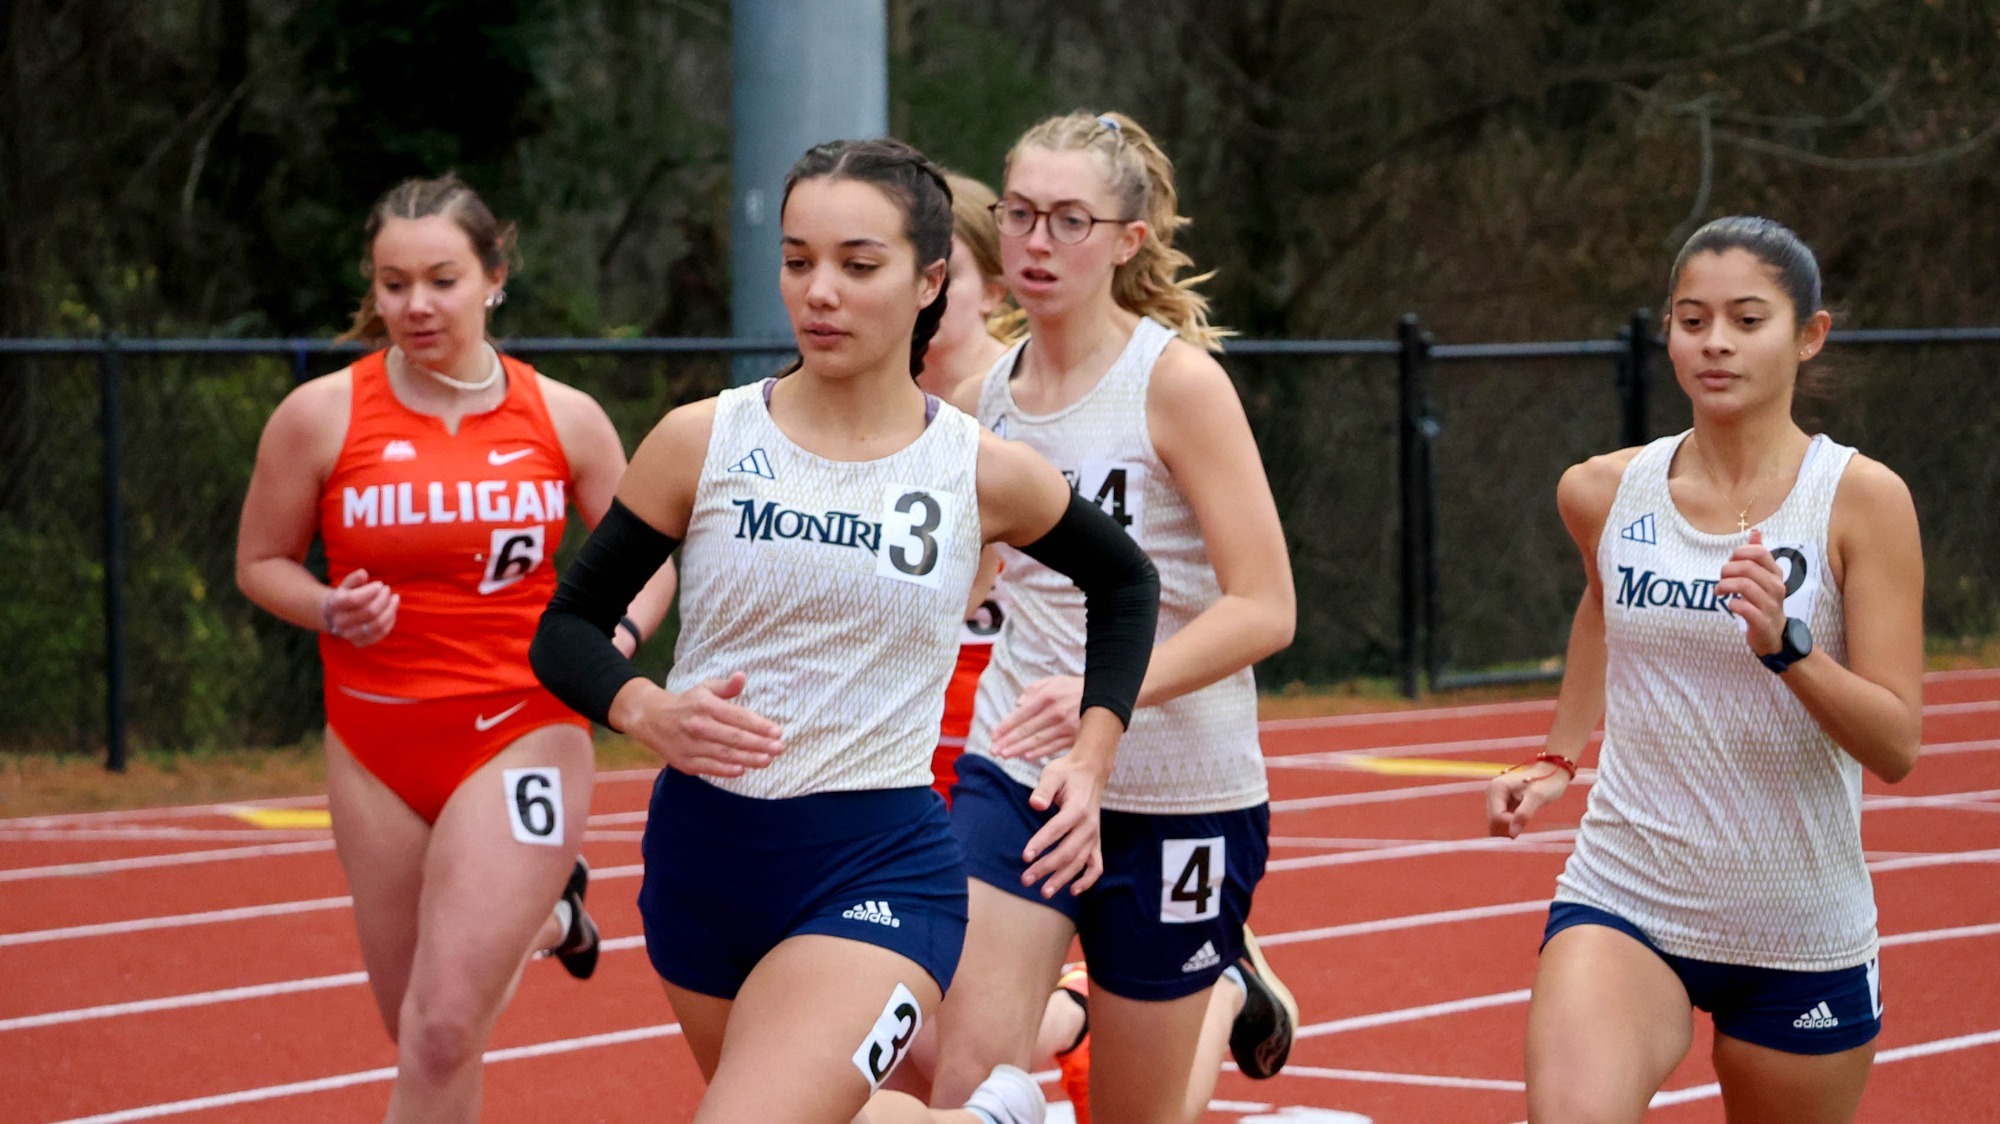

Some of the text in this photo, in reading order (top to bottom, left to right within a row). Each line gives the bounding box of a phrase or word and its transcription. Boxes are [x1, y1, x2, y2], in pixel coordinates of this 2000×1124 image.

[343, 480, 565, 528] MILLIGAN
[493, 535, 535, 581] 6
[889, 491, 942, 577] 3
[516, 774, 556, 837] 6
[1171, 845, 1212, 914] 4
[842, 908, 900, 928] adidas
[869, 1002, 917, 1082] 3
[1792, 1016, 1839, 1029] adidas
